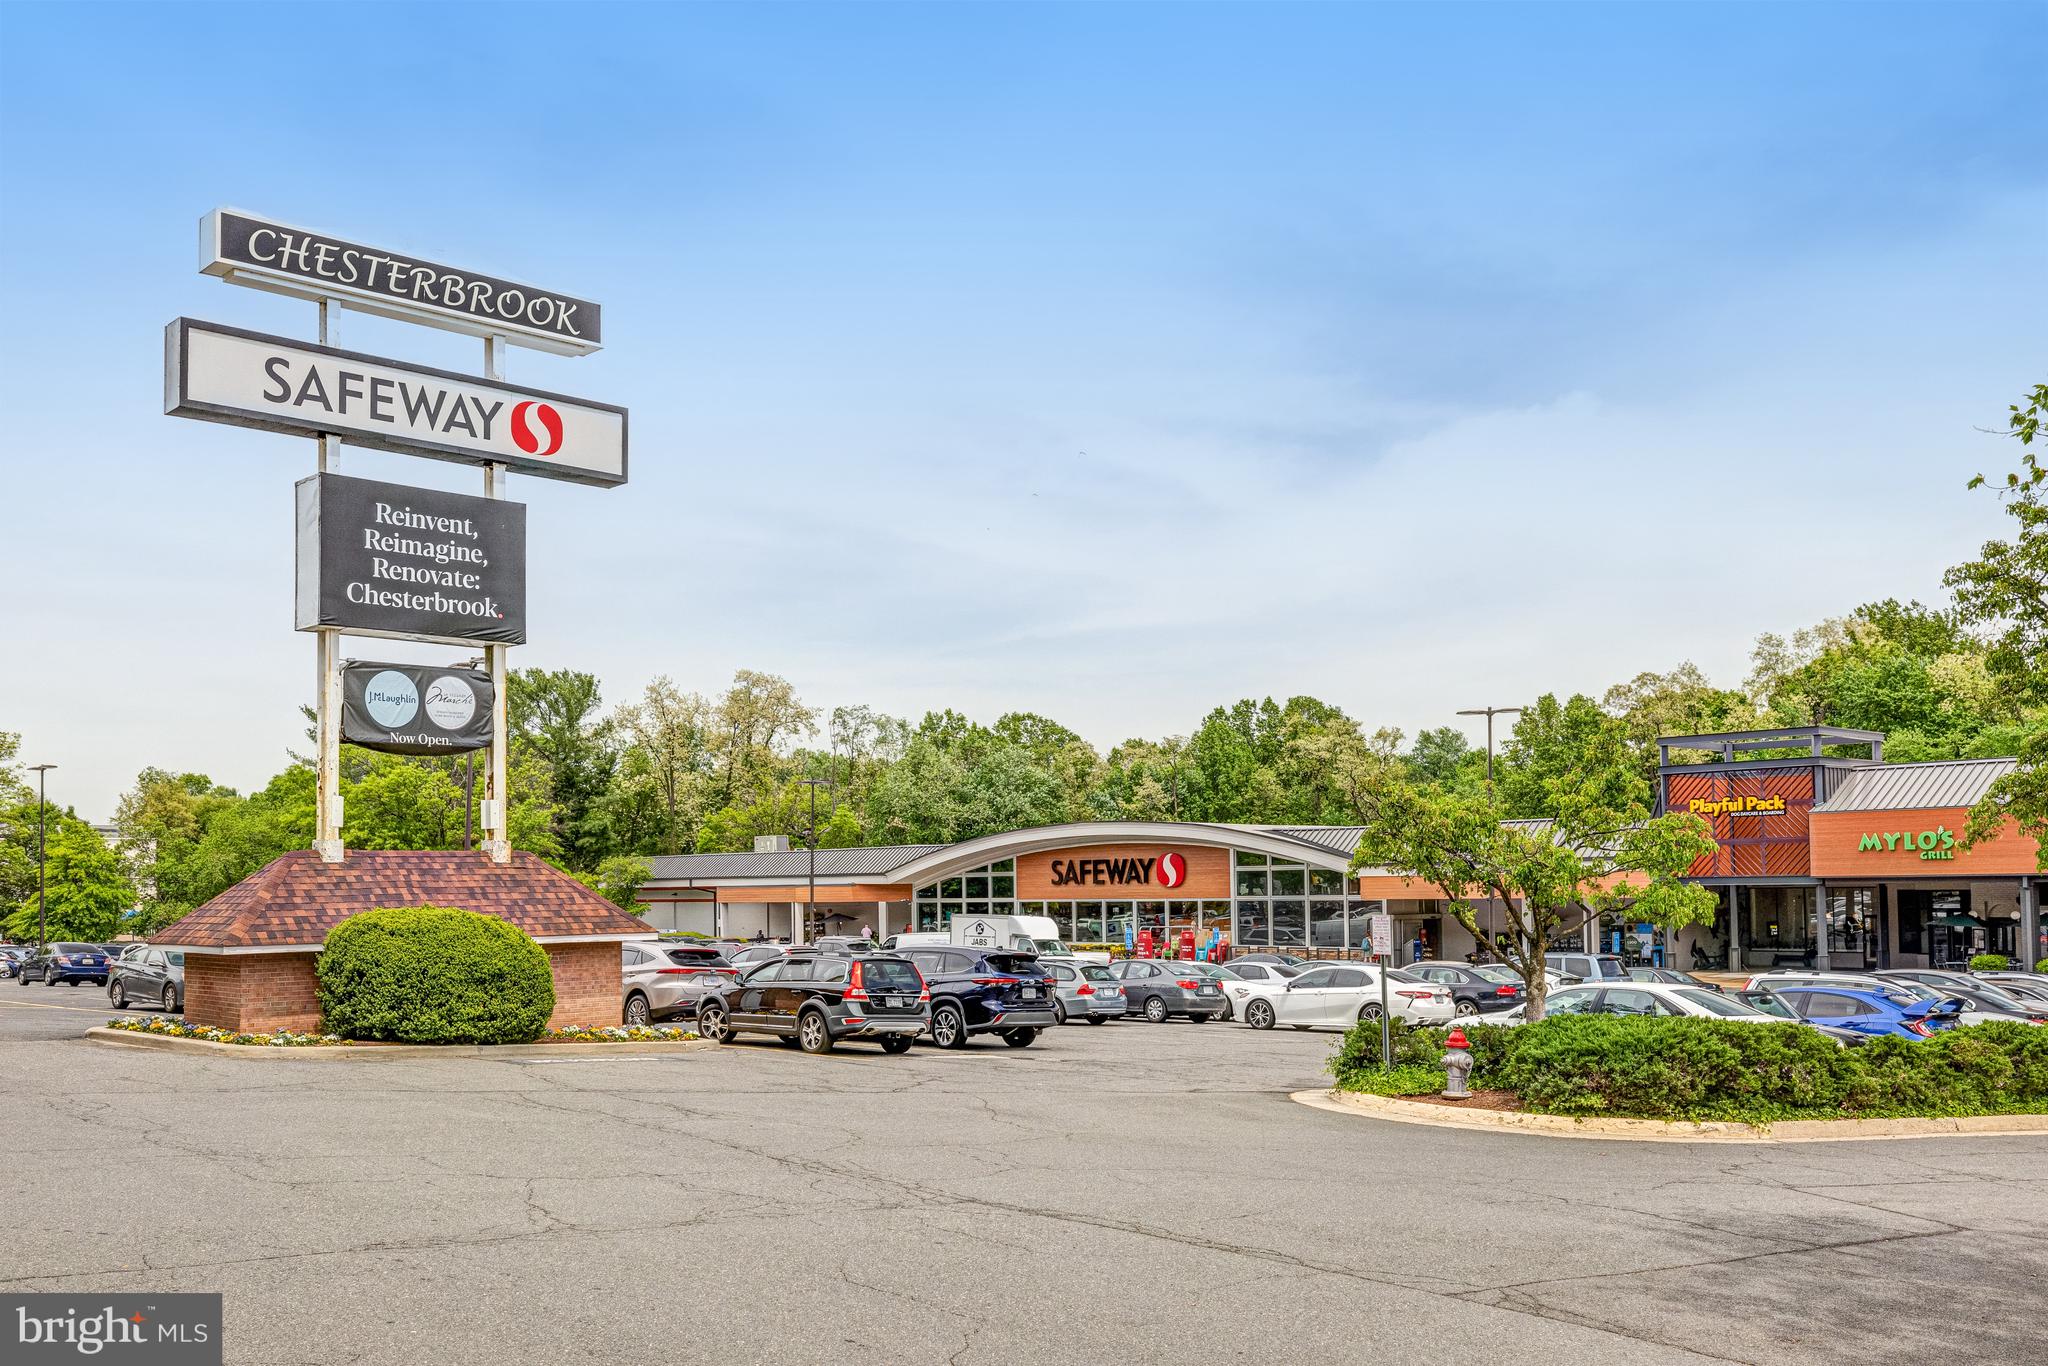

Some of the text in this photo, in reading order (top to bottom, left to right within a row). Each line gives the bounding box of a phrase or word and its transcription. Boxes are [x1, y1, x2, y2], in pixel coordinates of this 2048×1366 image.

[247, 228, 581, 336] CHESTERBROOK
[263, 356, 504, 440] SAFEWAY
[375, 502, 478, 539] Reinvent,
[364, 528, 488, 567] Reimagine,
[372, 557, 480, 589] Renovate:
[346, 582, 503, 619] Chesterbrook.
[390, 732, 452, 747] Now Open.
[1689, 794, 1785, 817] Playful Pack
[1858, 825, 1955, 851] MYLO'S
[1920, 851, 1954, 860] GRILL
[1051, 857, 1157, 885] SAFEWAY
[971, 938, 988, 946] JABS
